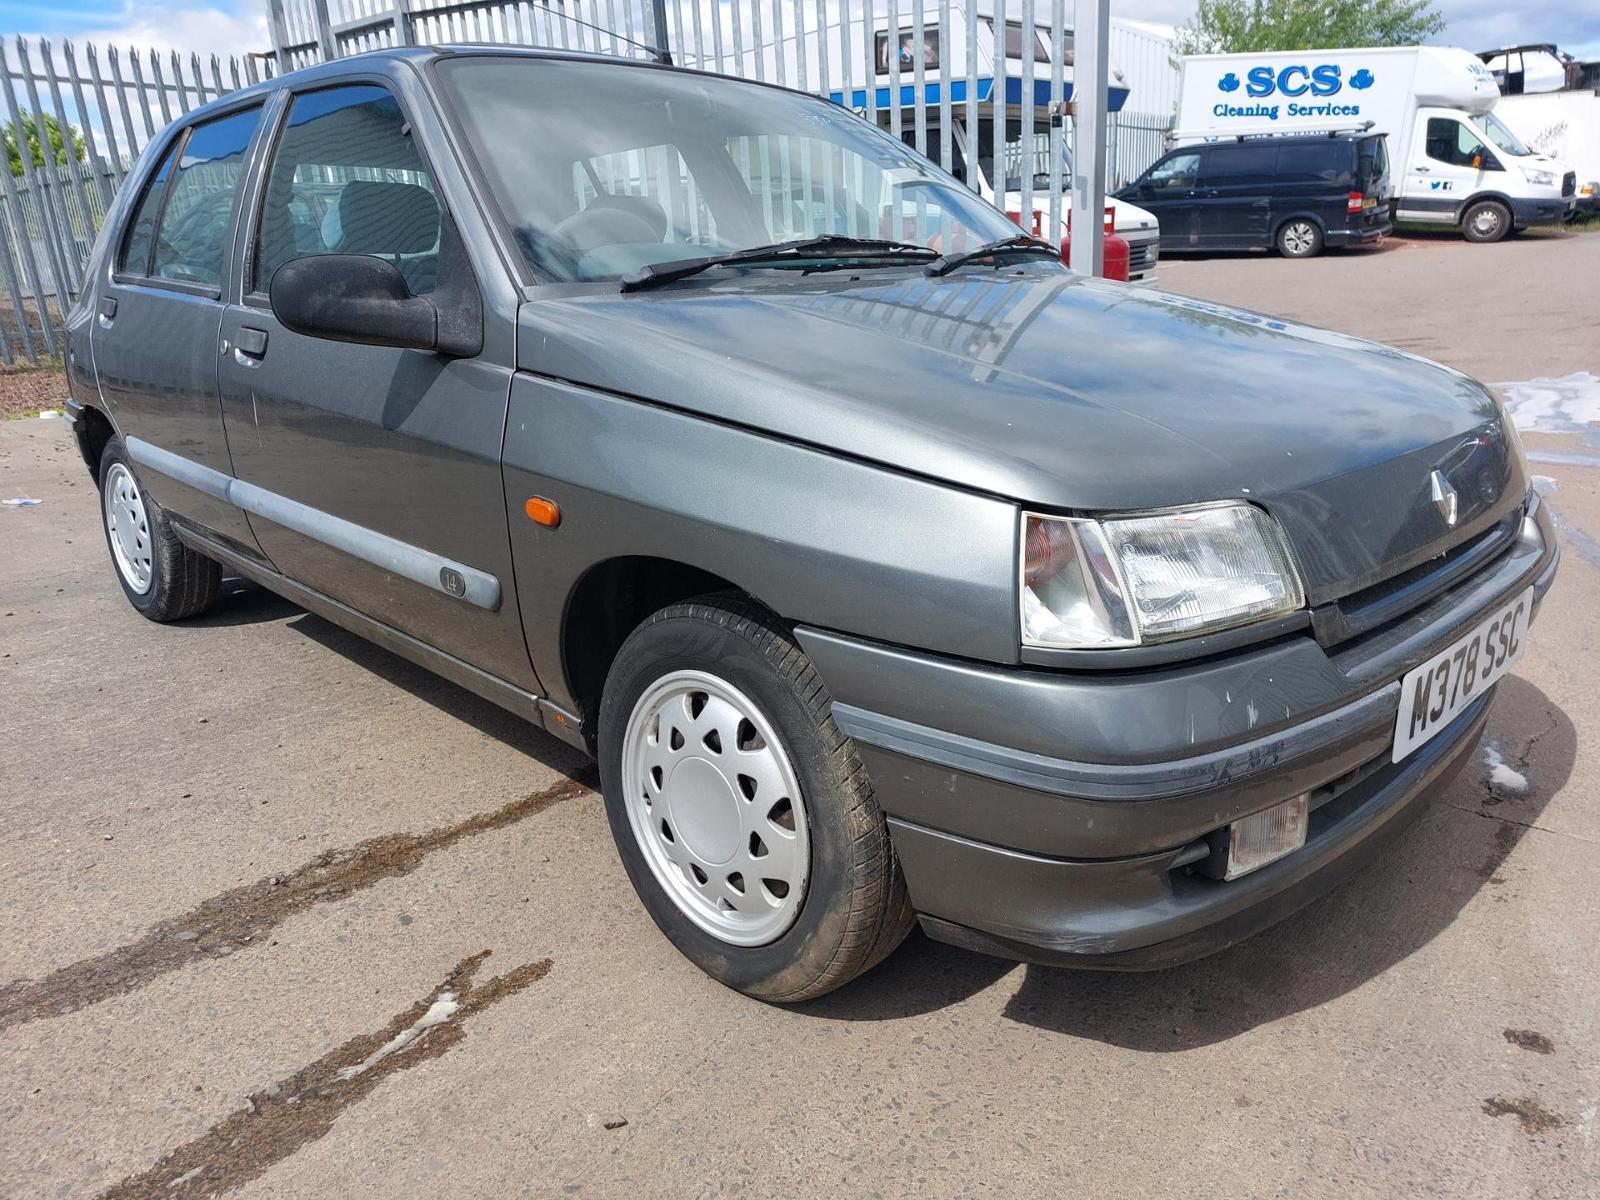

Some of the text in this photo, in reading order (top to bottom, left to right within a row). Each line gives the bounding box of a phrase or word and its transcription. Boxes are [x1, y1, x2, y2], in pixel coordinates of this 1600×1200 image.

[1245, 64, 1342, 98] SCS
[1213, 102, 1360, 120] Cleaning Services
[1408, 601, 1524, 740] M378 SSC
